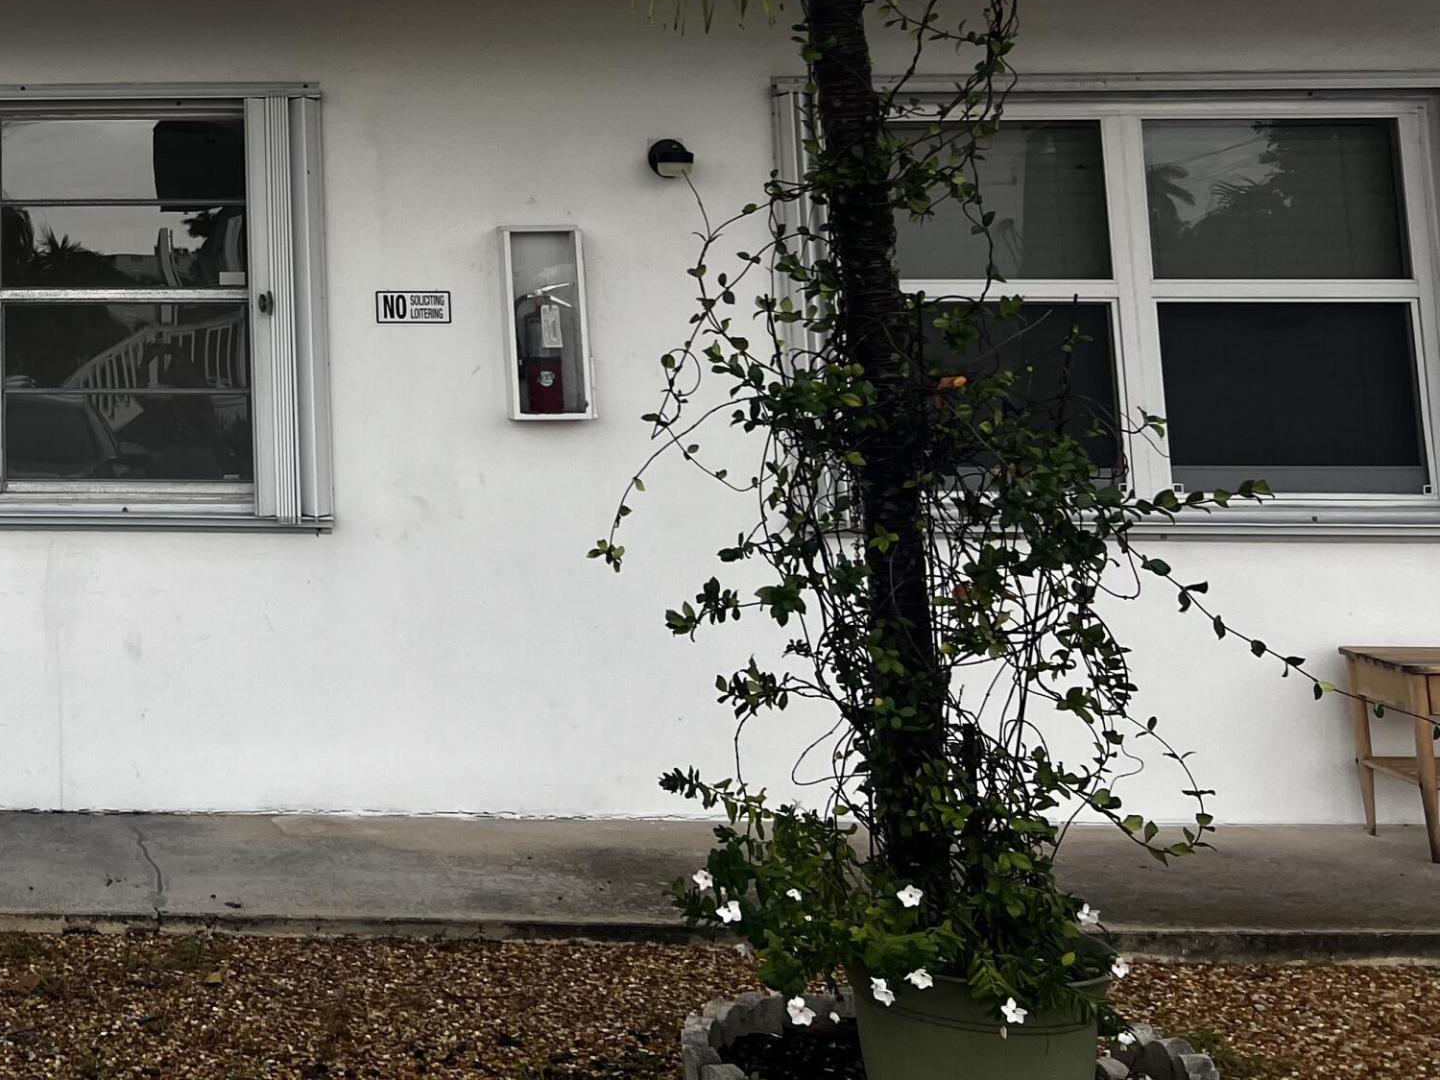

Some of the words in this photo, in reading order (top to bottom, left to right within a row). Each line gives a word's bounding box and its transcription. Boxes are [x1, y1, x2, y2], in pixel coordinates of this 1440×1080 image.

[383, 294, 407, 319] NO
[410, 295, 445, 306] SOLICITING
[410, 307, 444, 319] LOITERING
